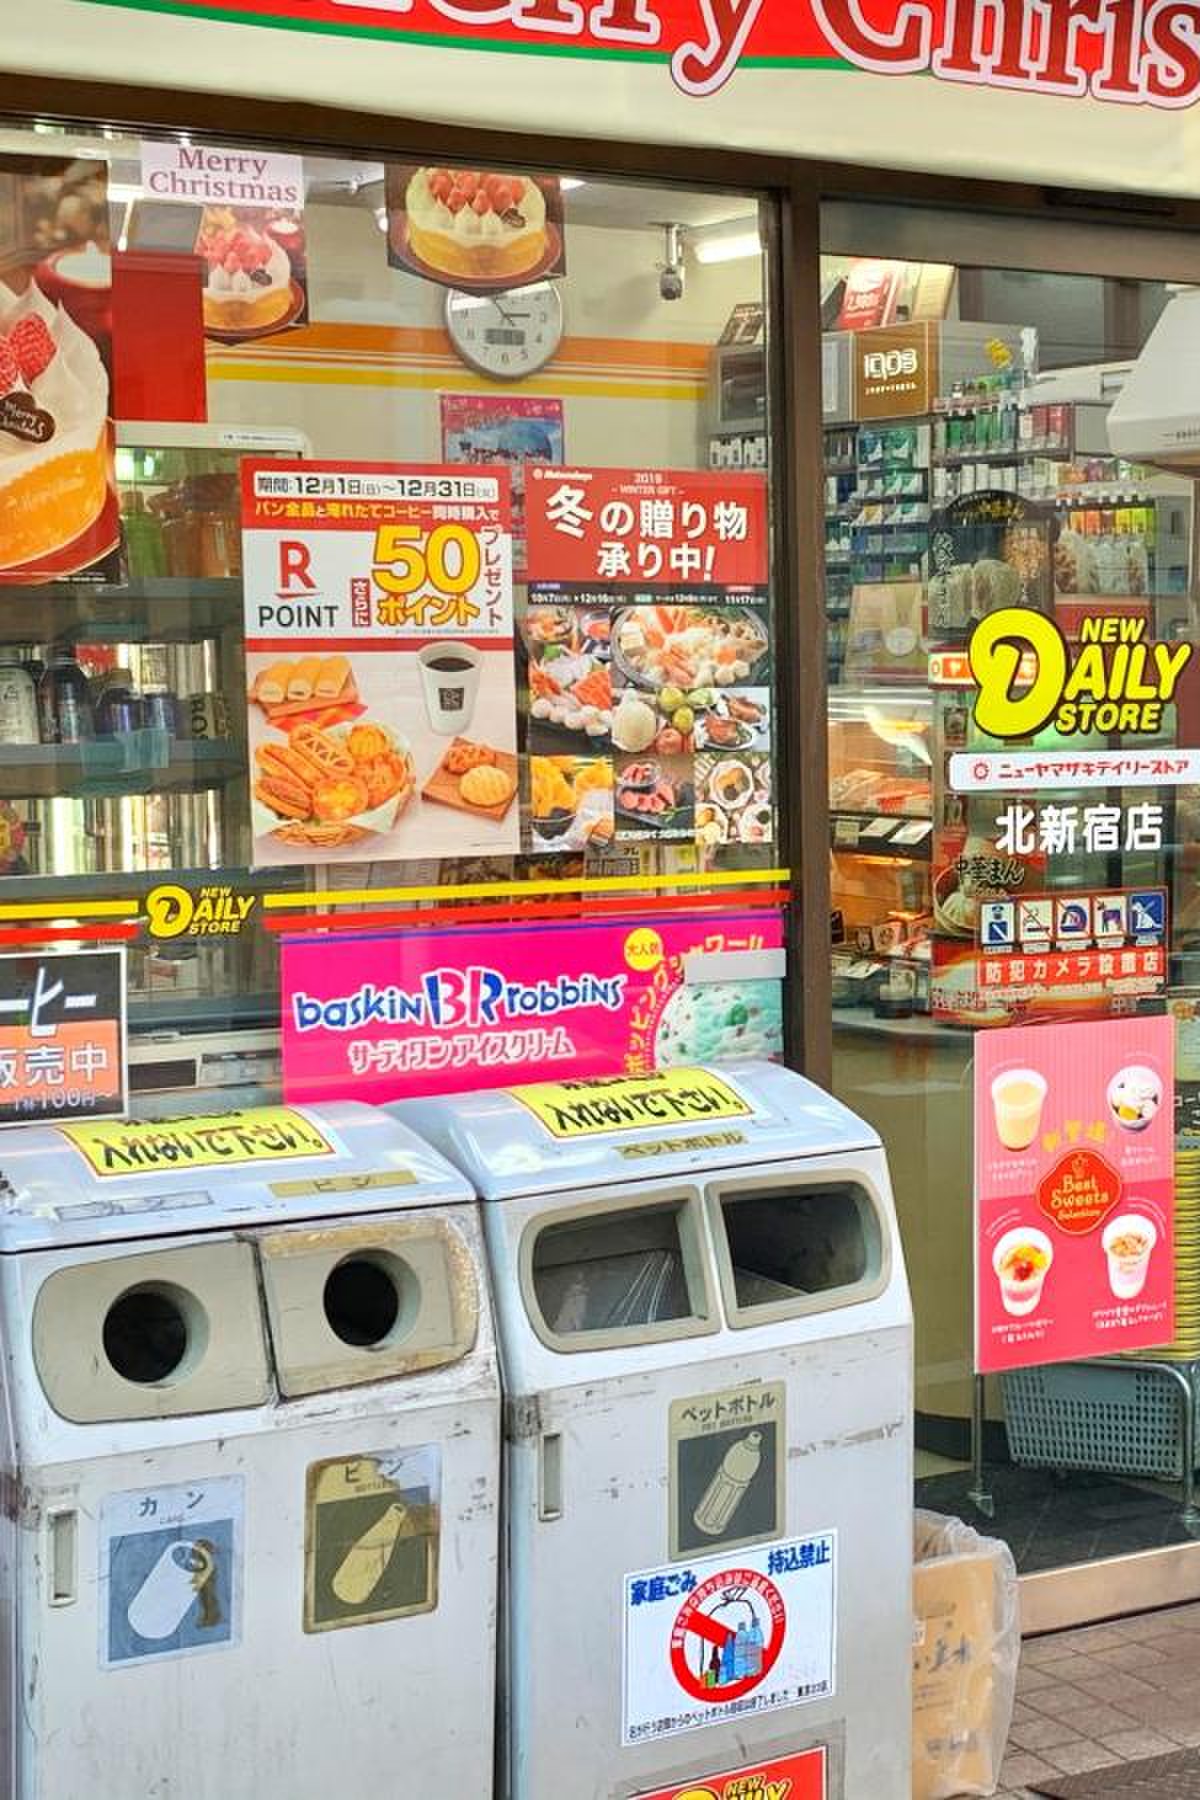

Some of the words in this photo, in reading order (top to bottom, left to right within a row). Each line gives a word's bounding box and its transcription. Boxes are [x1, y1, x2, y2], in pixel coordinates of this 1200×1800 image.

[178, 149, 267, 180] Merry
[150, 171, 297, 202] Christmas
[545, 484, 748, 541] 冬の贈り物
[278, 540, 317, 592] R
[372, 524, 481, 594] 50
[483, 524, 503, 627] プレゼント
[597, 542, 716, 582] 承り中!
[259, 605, 338, 627] POINT
[376, 593, 480, 627] ポイント
[1081, 618, 1145, 643] NEW
[968, 606, 1192, 737] DAILY
[1055, 702, 1163, 734] STORE
[998, 759, 1190, 779] ニューヤマザキデイリーストア
[995, 801, 1164, 855] 北新宿店
[200, 887, 231, 897] NEW
[146, 883, 256, 938] DAILY
[189, 921, 241, 935] STORE
[985, 952, 1160, 984] 防犯カメラ設置店
[295, 984, 426, 1031] baskin
[424, 968, 502, 1028] BR
[505, 974, 627, 1016] robbins
[349, 1029, 576, 1074] サーティワンアイスクリーム
[681, 1392, 776, 1422] ペットボトル
[345, 1457, 403, 1485] ビン
[140, 1490, 204, 1518] カン
[768, 1539, 831, 1576] 持込禁止
[631, 1570, 698, 1606] 家庭ごみ
